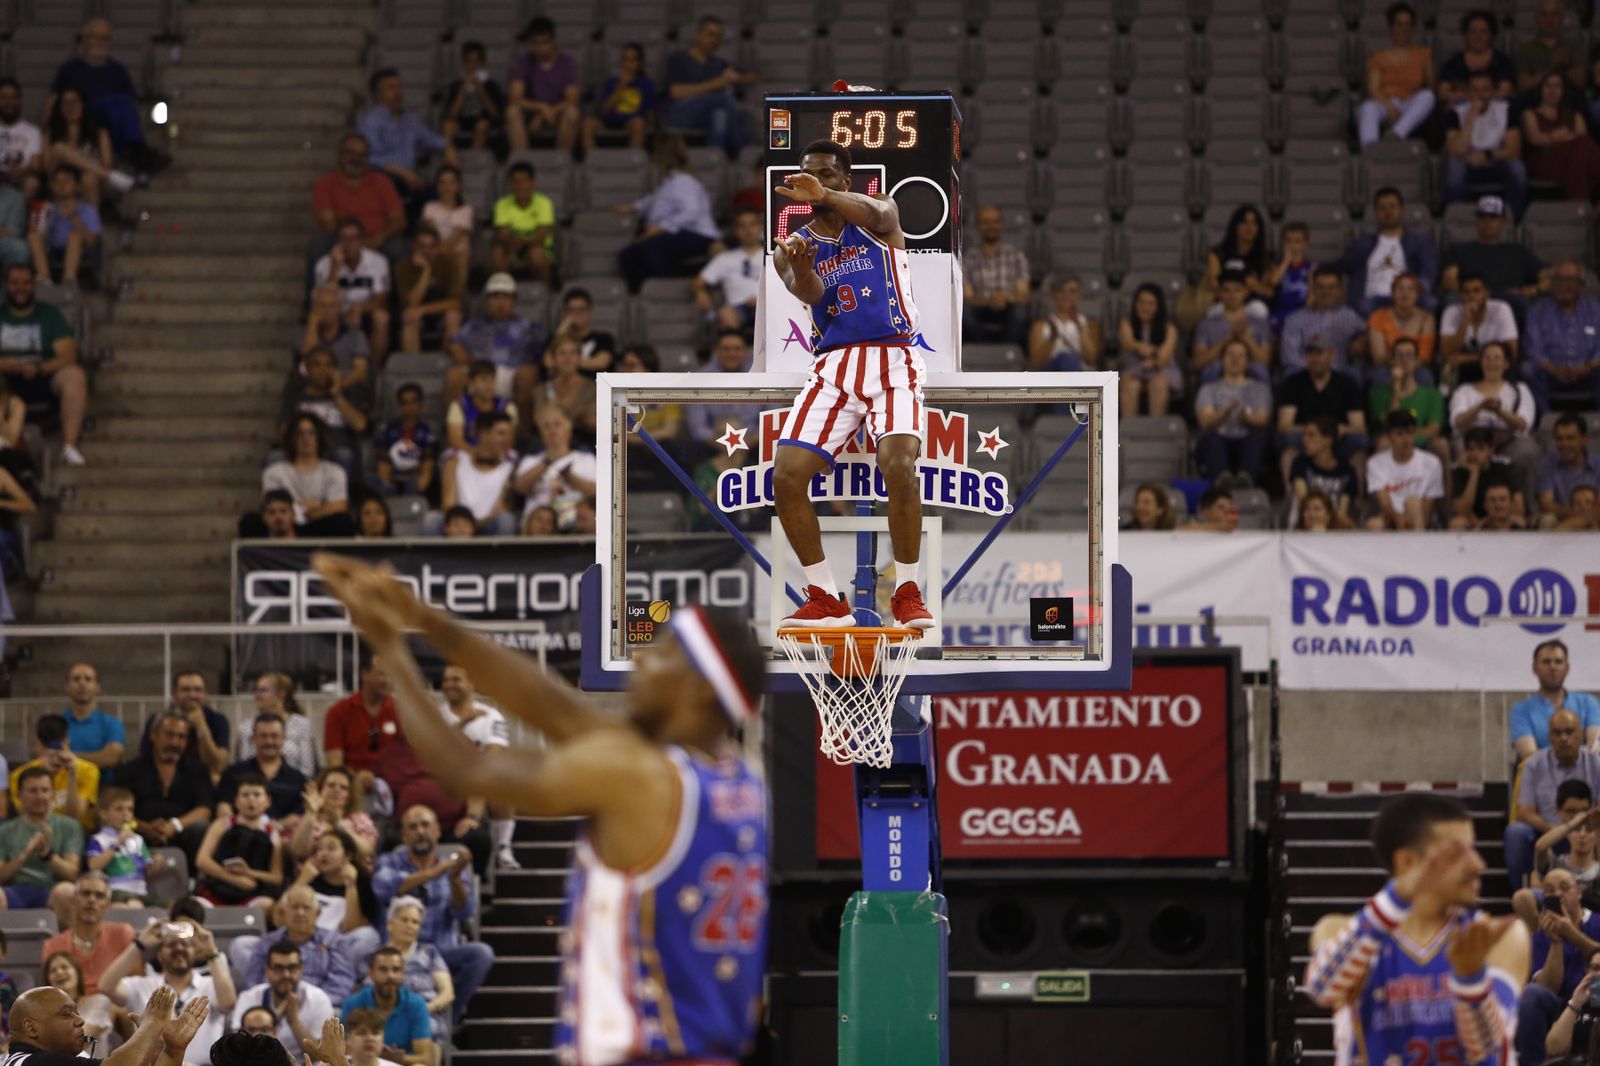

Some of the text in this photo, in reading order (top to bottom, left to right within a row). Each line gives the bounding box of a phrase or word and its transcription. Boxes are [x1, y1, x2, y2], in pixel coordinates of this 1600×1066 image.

[831, 110, 917, 148] 6:05
[628, 606, 645, 617] Liga
[1292, 576, 1503, 627] RADIO
[628, 621, 654, 633] LEB
[628, 632, 653, 642] ORO
[1293, 637, 1414, 656] GRANADA
[938, 695, 1202, 729] NTAMIENTO
[888, 815, 902, 882] MONDO
